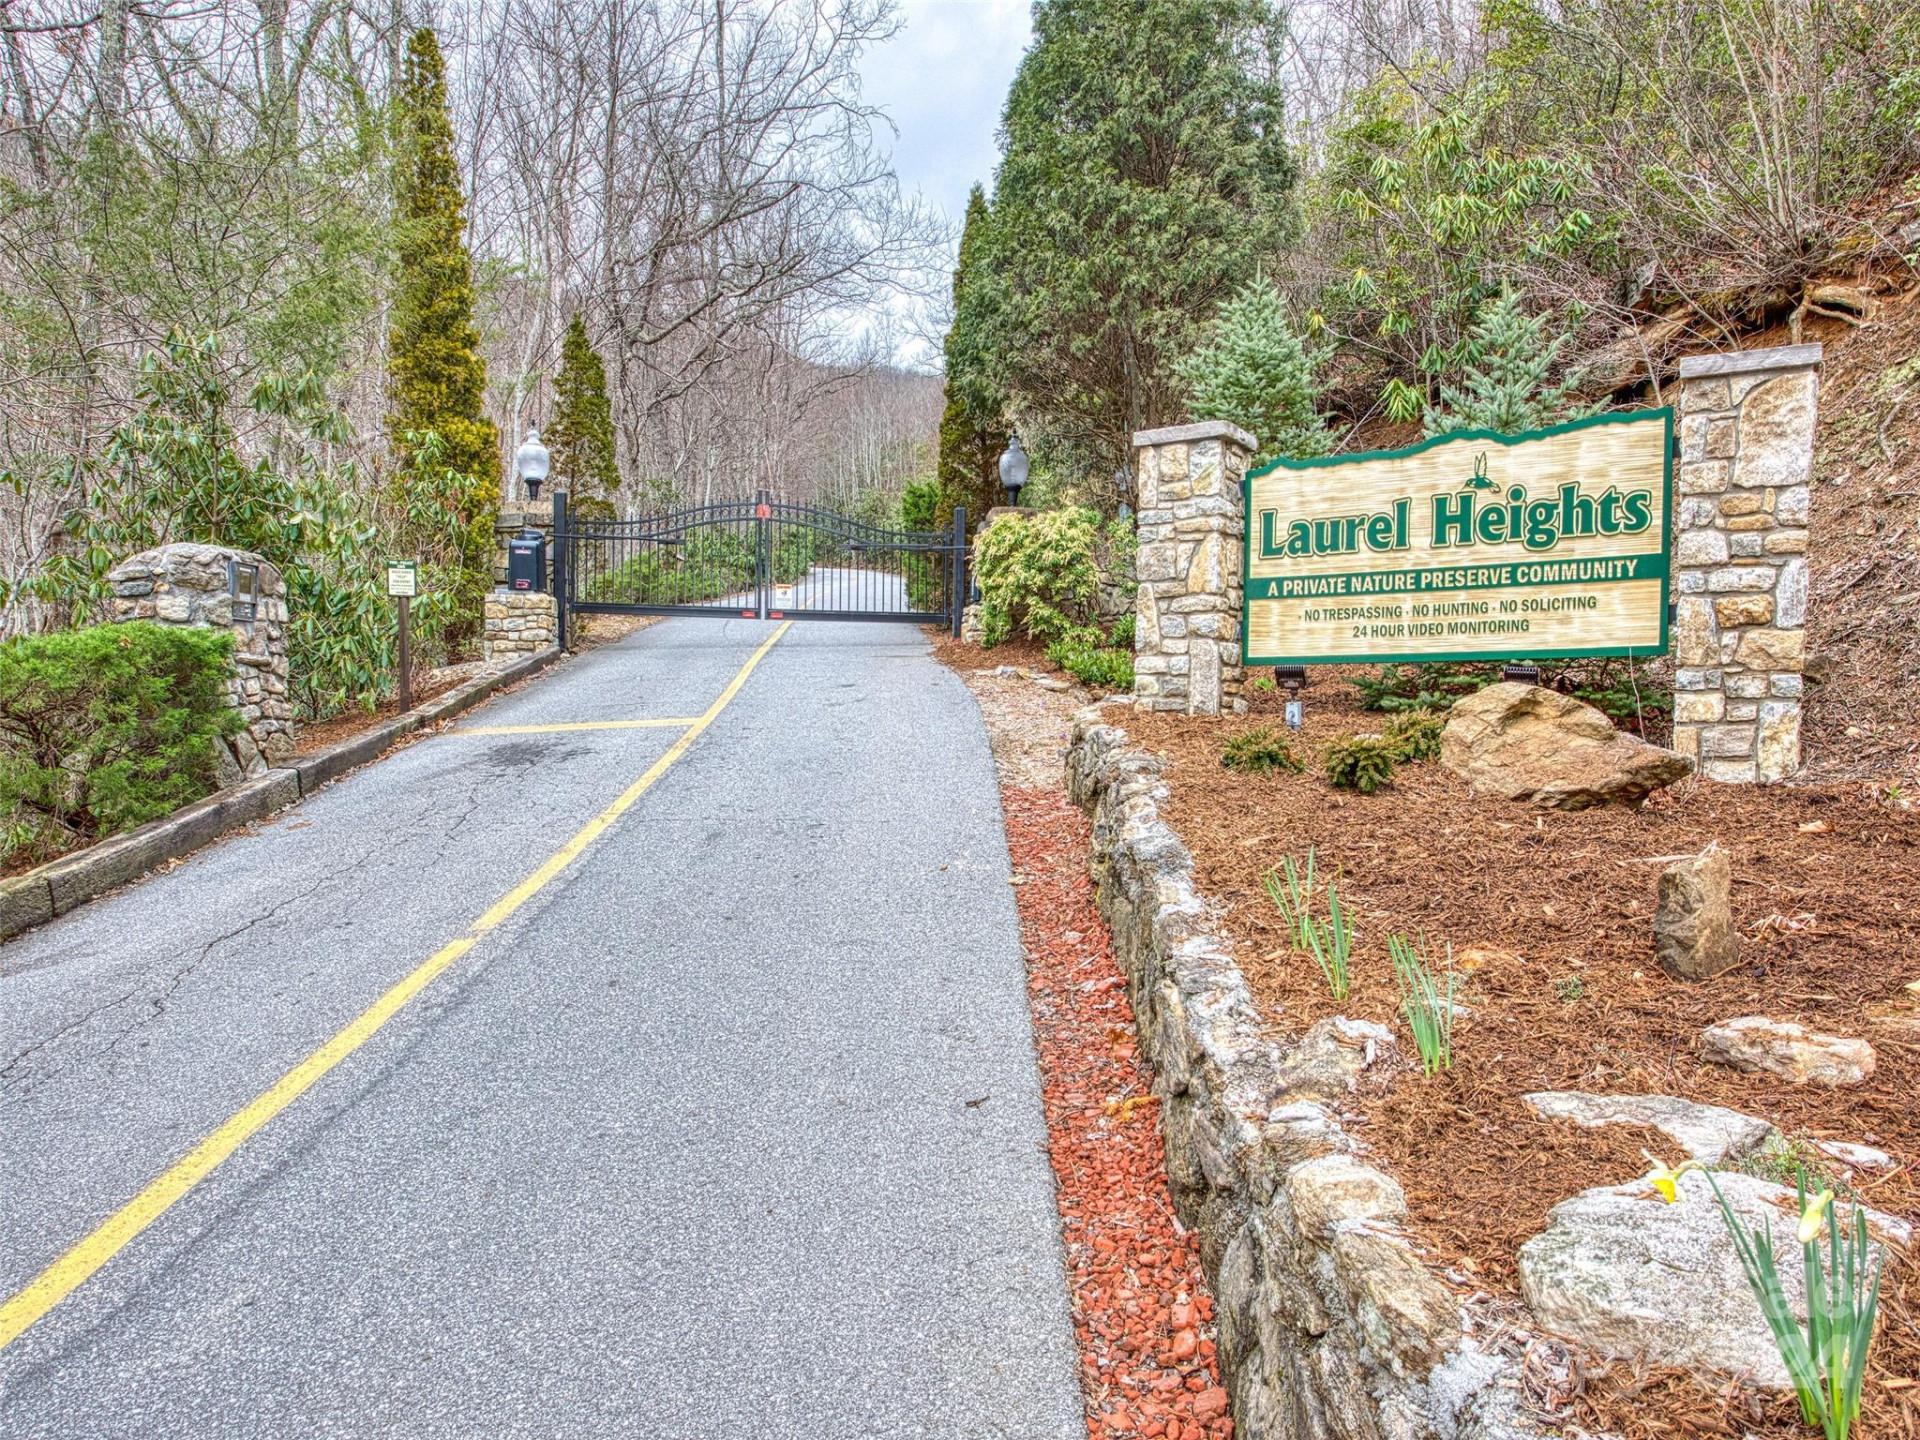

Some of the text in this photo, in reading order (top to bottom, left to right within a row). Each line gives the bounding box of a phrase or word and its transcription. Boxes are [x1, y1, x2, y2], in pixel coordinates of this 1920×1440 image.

[1259, 481, 1652, 560] Laurel Heights
[1268, 559, 1638, 597] A PRIVATE NATURE PRESERVE COMMUNITY
[1304, 596, 1597, 621] NO TRESPASSING NO HUNTING NO SOLICITING
[1353, 619, 1530, 638] 24 HOUR VIDEO MONITORING
